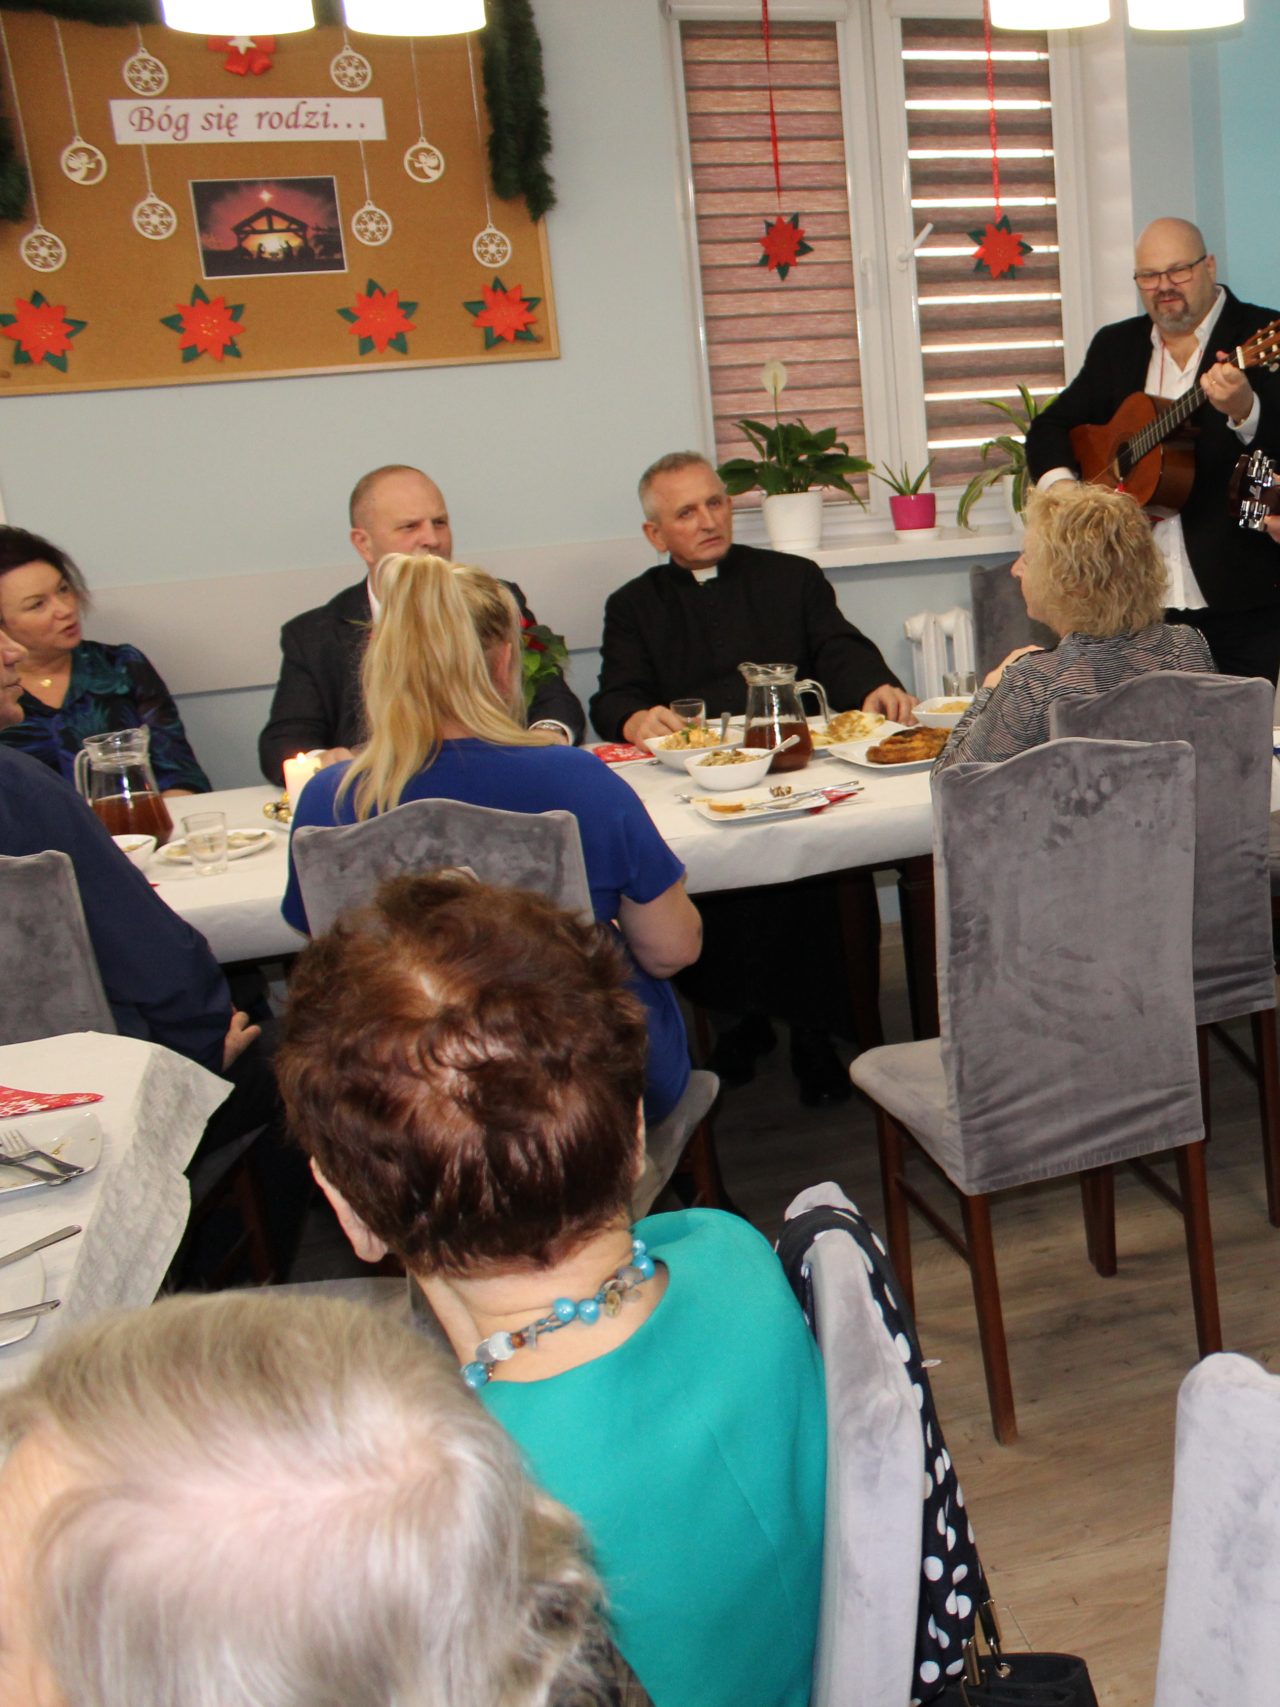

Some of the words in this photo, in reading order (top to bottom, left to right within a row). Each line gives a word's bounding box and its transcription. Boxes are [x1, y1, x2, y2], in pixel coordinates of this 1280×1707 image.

[128, 105, 190, 141] Bóg
[200, 104, 239, 137] się
[256, 101, 366, 130] rodzi...
